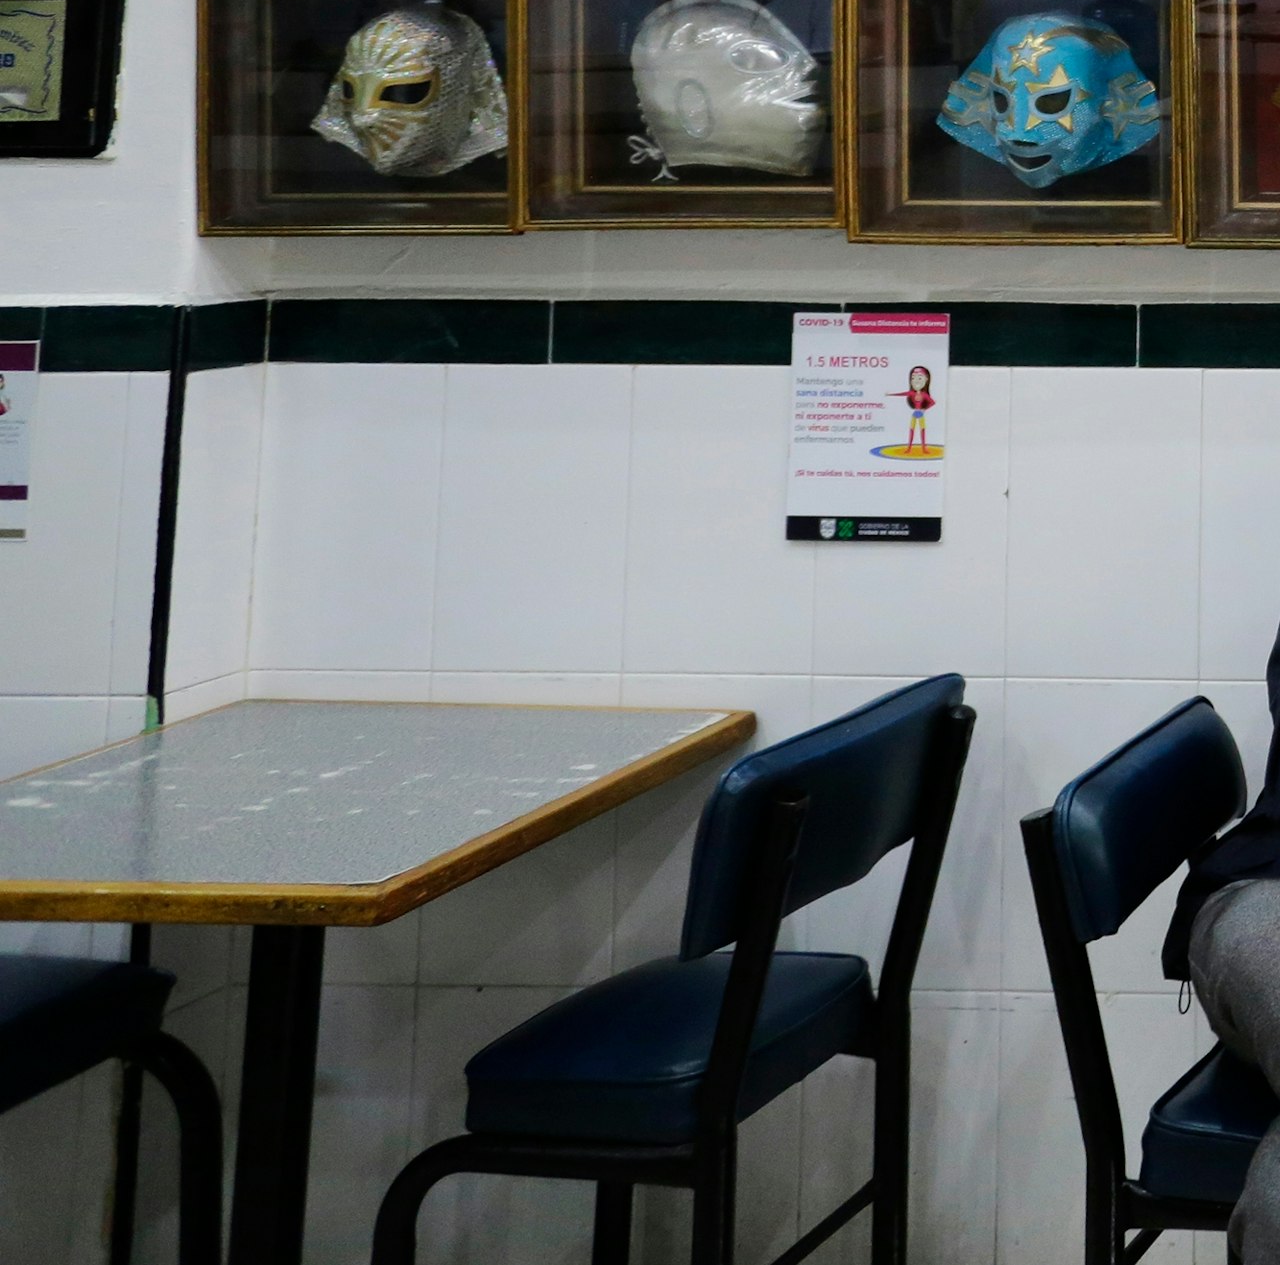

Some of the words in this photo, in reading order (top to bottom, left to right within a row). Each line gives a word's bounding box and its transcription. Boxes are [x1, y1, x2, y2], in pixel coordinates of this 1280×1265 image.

[799, 318, 844, 327] COVID-19
[806, 356, 825, 368] 1.5
[829, 356, 889, 368] METROS
[796, 377, 844, 388] Mantengo
[819, 388, 864, 397] distancia
[806, 413, 855, 421] exponerte
